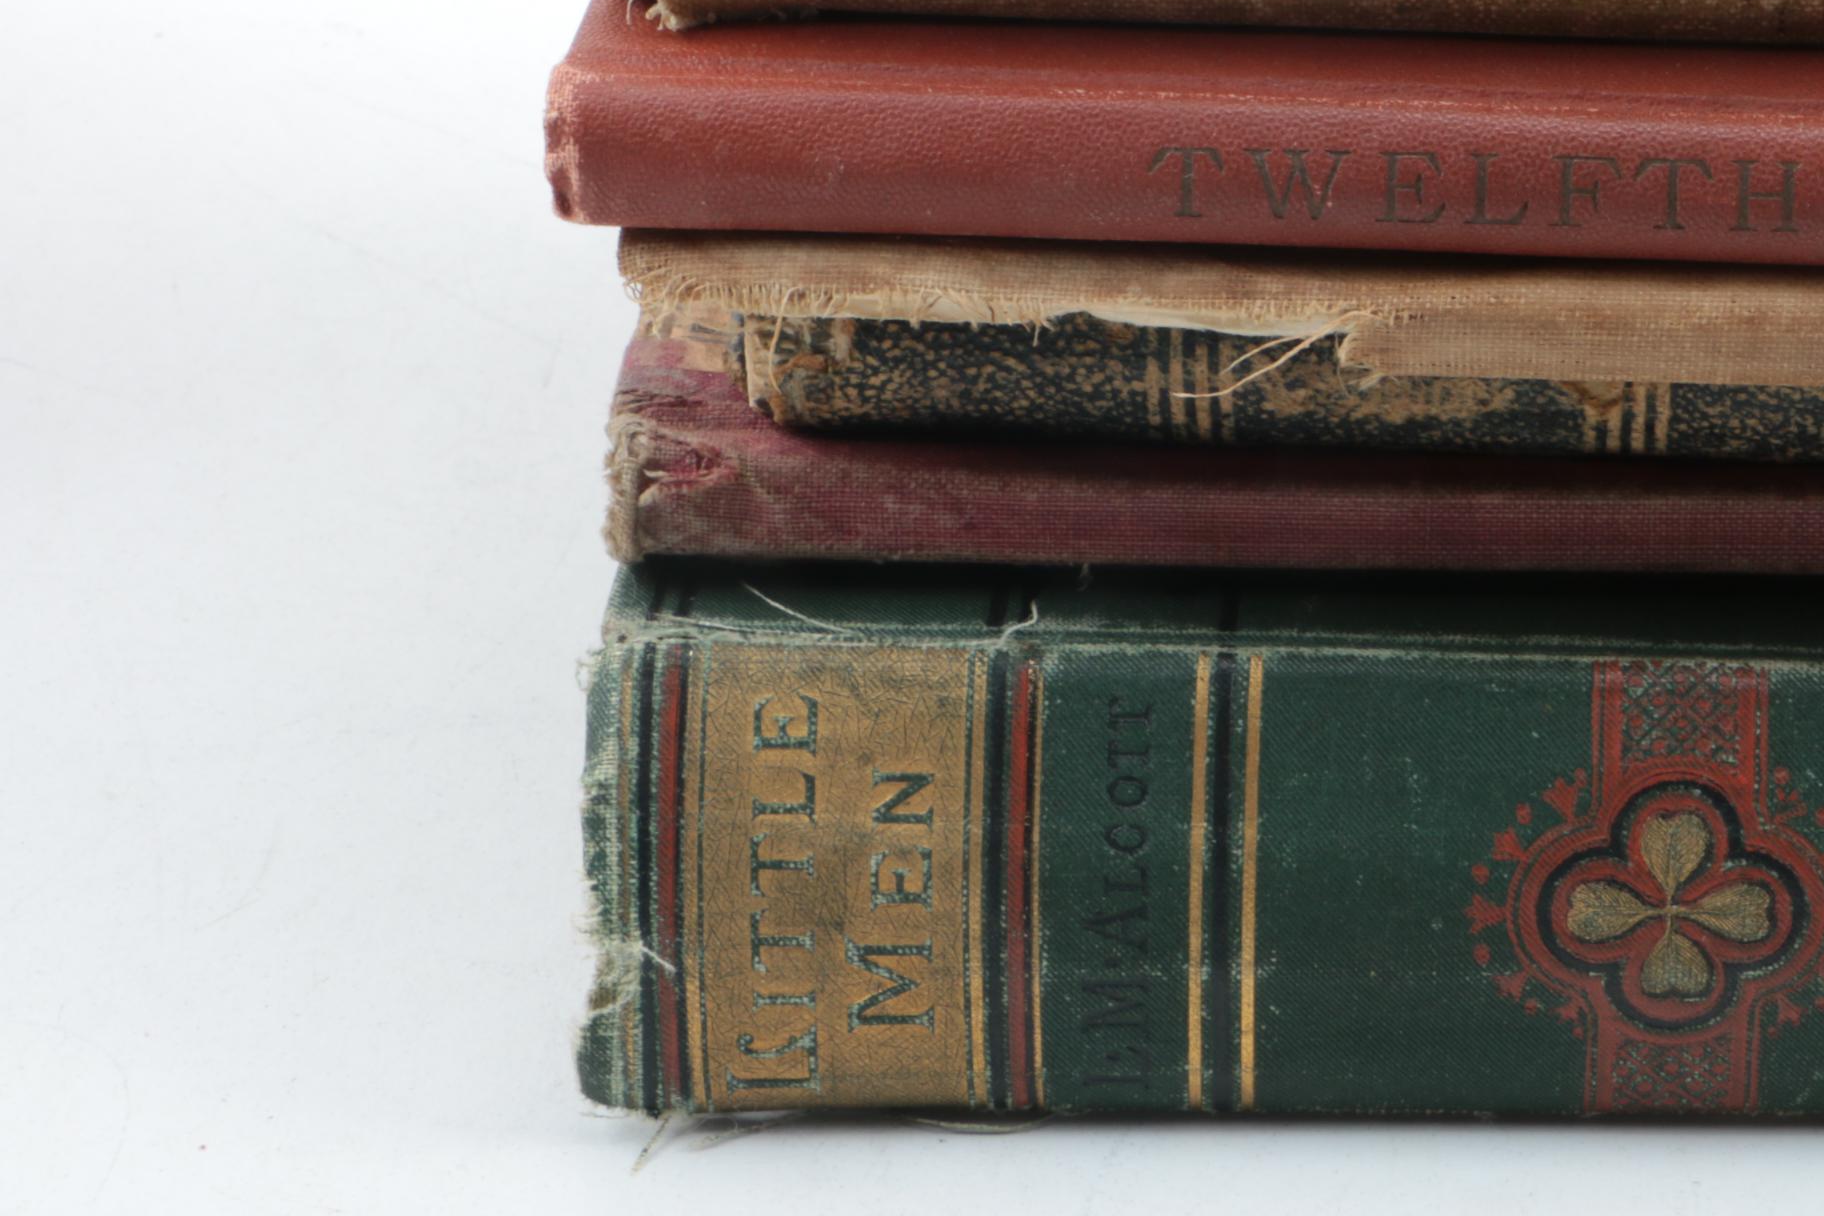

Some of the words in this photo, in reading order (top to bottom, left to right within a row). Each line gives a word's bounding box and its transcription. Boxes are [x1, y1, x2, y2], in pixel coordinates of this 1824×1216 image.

[1149, 147, 1801, 233] TWELFTH
[725, 693, 822, 1096] LITTLE
[844, 768, 935, 1034] MEN
